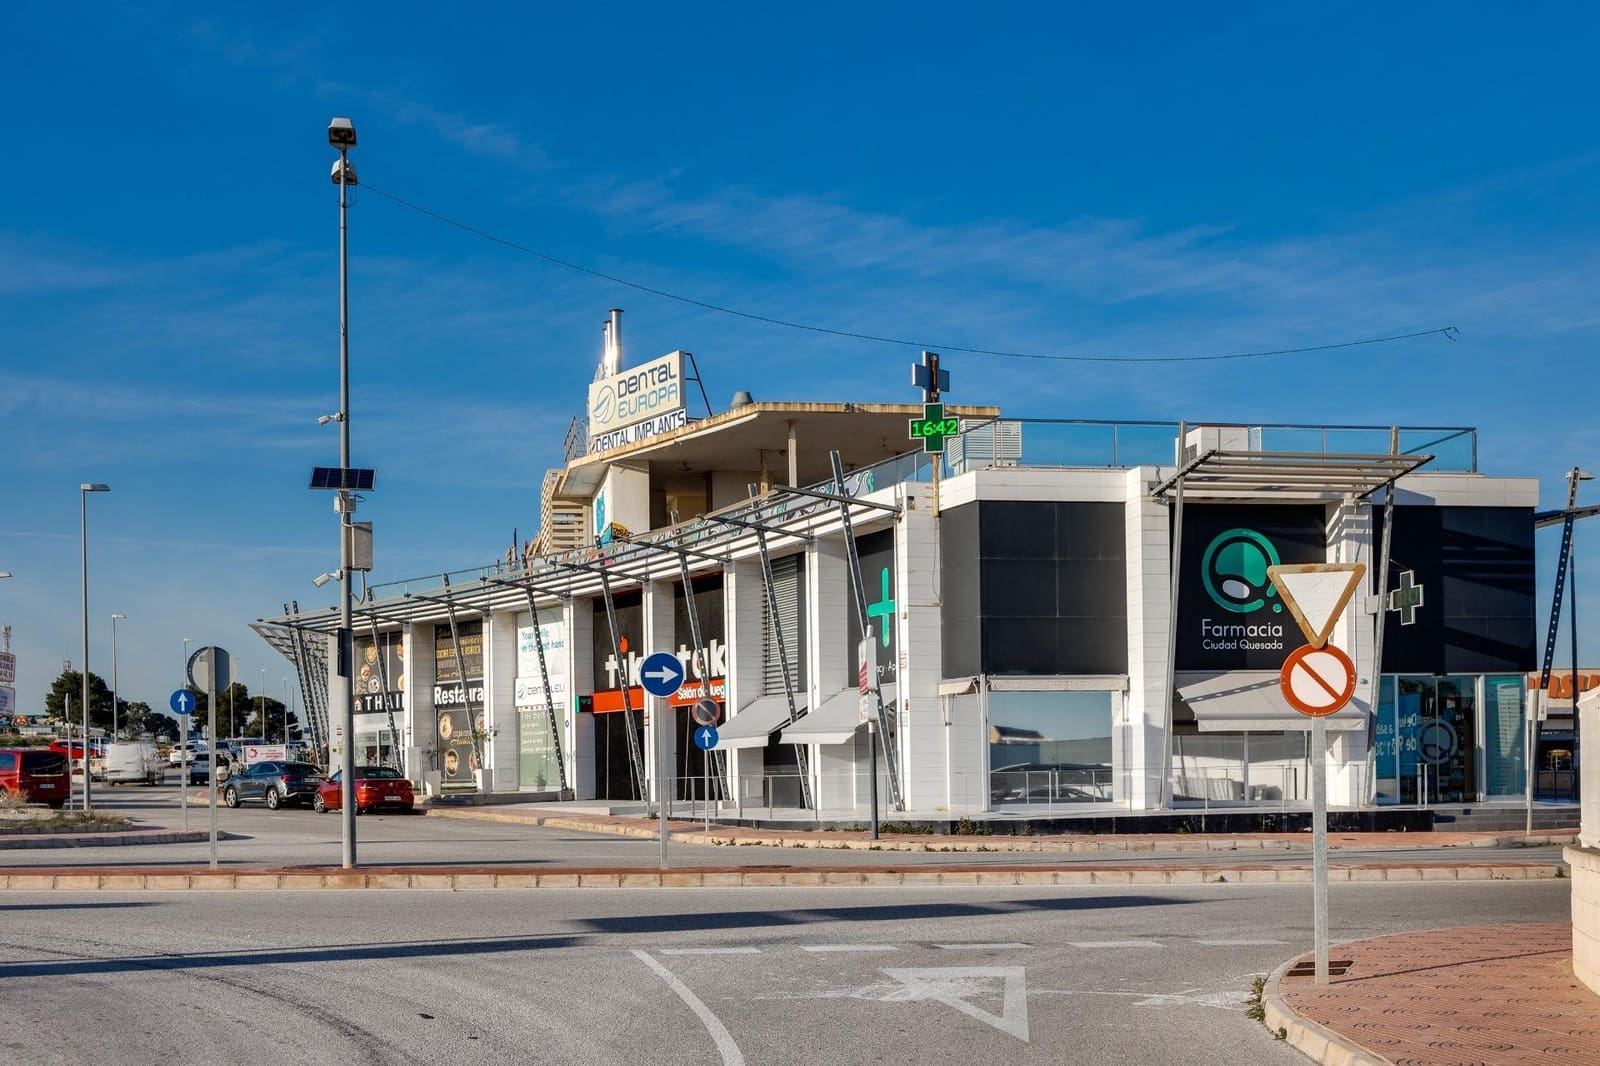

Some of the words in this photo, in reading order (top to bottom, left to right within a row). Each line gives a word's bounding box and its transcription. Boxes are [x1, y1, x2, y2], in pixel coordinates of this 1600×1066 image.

[595, 428, 631, 453] DENTAL
[634, 410, 685, 441] IMPLANTS
[1201, 618, 1283, 637] Farmacia
[1202, 639, 1237, 650] Ciudad
[1239, 638, 1283, 650] Quesada
